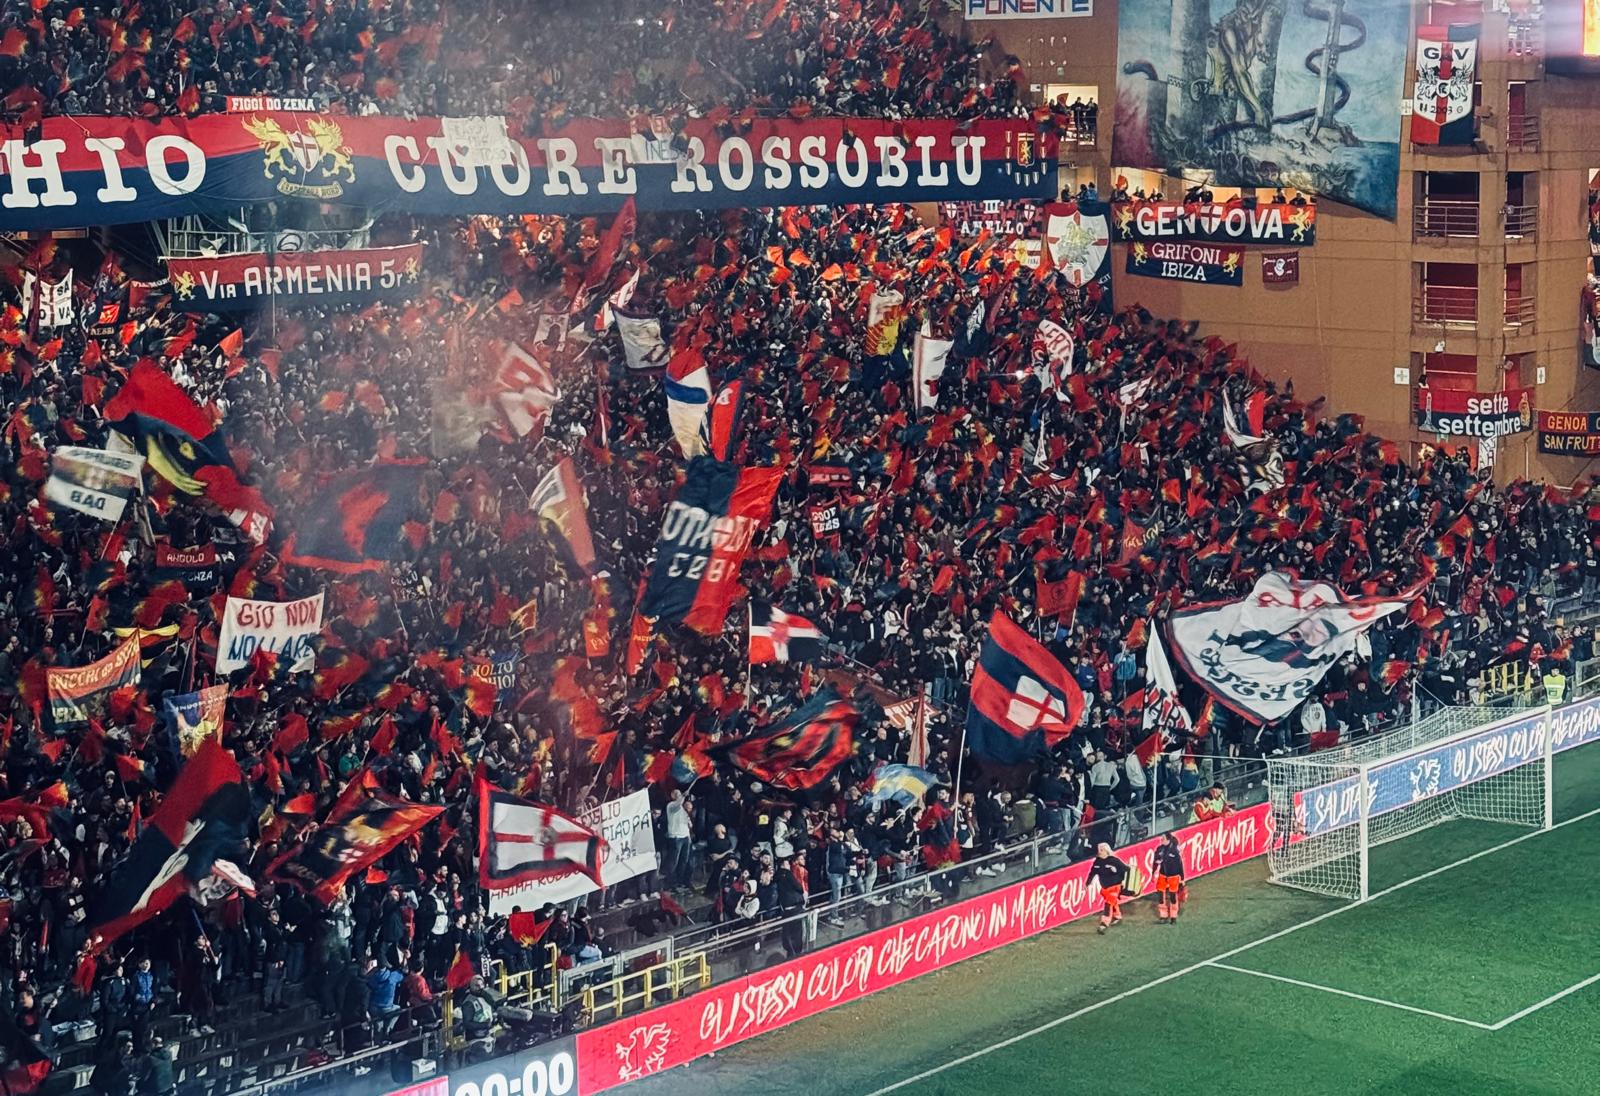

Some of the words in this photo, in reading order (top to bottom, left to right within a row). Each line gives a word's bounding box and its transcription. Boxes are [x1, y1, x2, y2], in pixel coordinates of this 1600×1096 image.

[232, 97, 264, 111] FIGGI
[265, 97, 282, 111] DO
[282, 97, 316, 111] ZENA
[0, 135, 206, 208] HIO
[385, 134, 638, 197] CUORE
[671, 135, 986, 194] ROSSOBLU
[1151, 242, 1221, 265] GRIFONI
[244, 262, 372, 297] ARMENIA
[1161, 262, 1207, 281] IBIZA
[1467, 393, 1509, 415] sette
[1438, 413, 1521, 438] settembre
[1547, 415, 1588, 431] GENOA
[1544, 434, 1565, 450] SAN
[285, 598, 320, 626] NON
[807, 945, 874, 1002] COLORI
